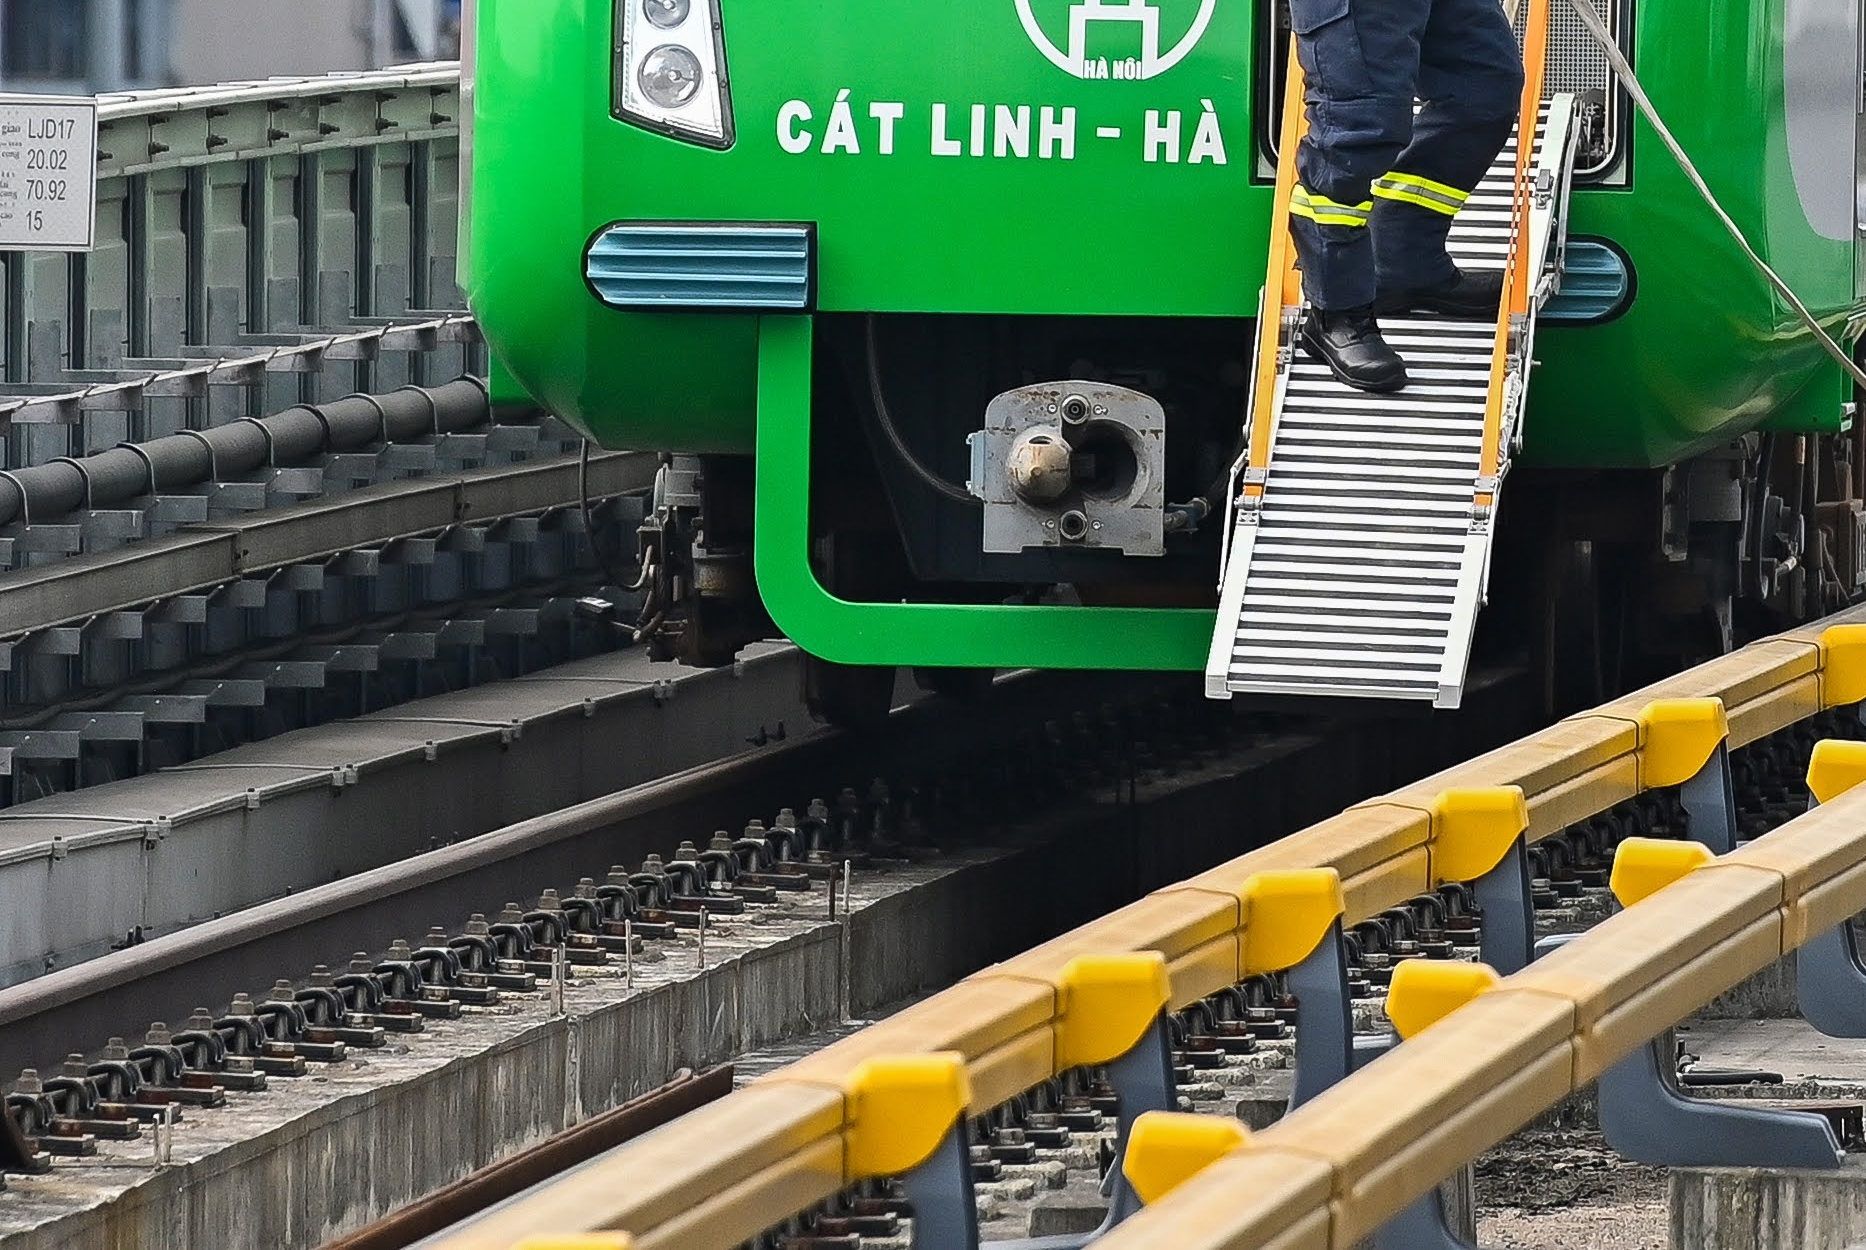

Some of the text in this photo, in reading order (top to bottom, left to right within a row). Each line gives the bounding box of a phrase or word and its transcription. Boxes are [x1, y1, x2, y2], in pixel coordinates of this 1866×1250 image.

[1083, 55, 1109, 79] HÀ
[28, 118, 75, 139] LJD17
[775, 88, 905, 154] CÁT
[930, 102, 1077, 160] LINH
[1142, 98, 1228, 166] HÀ
[26, 148, 67, 170] 20.02
[25, 179, 66, 201] 70.92
[26, 210, 43, 231] 15
